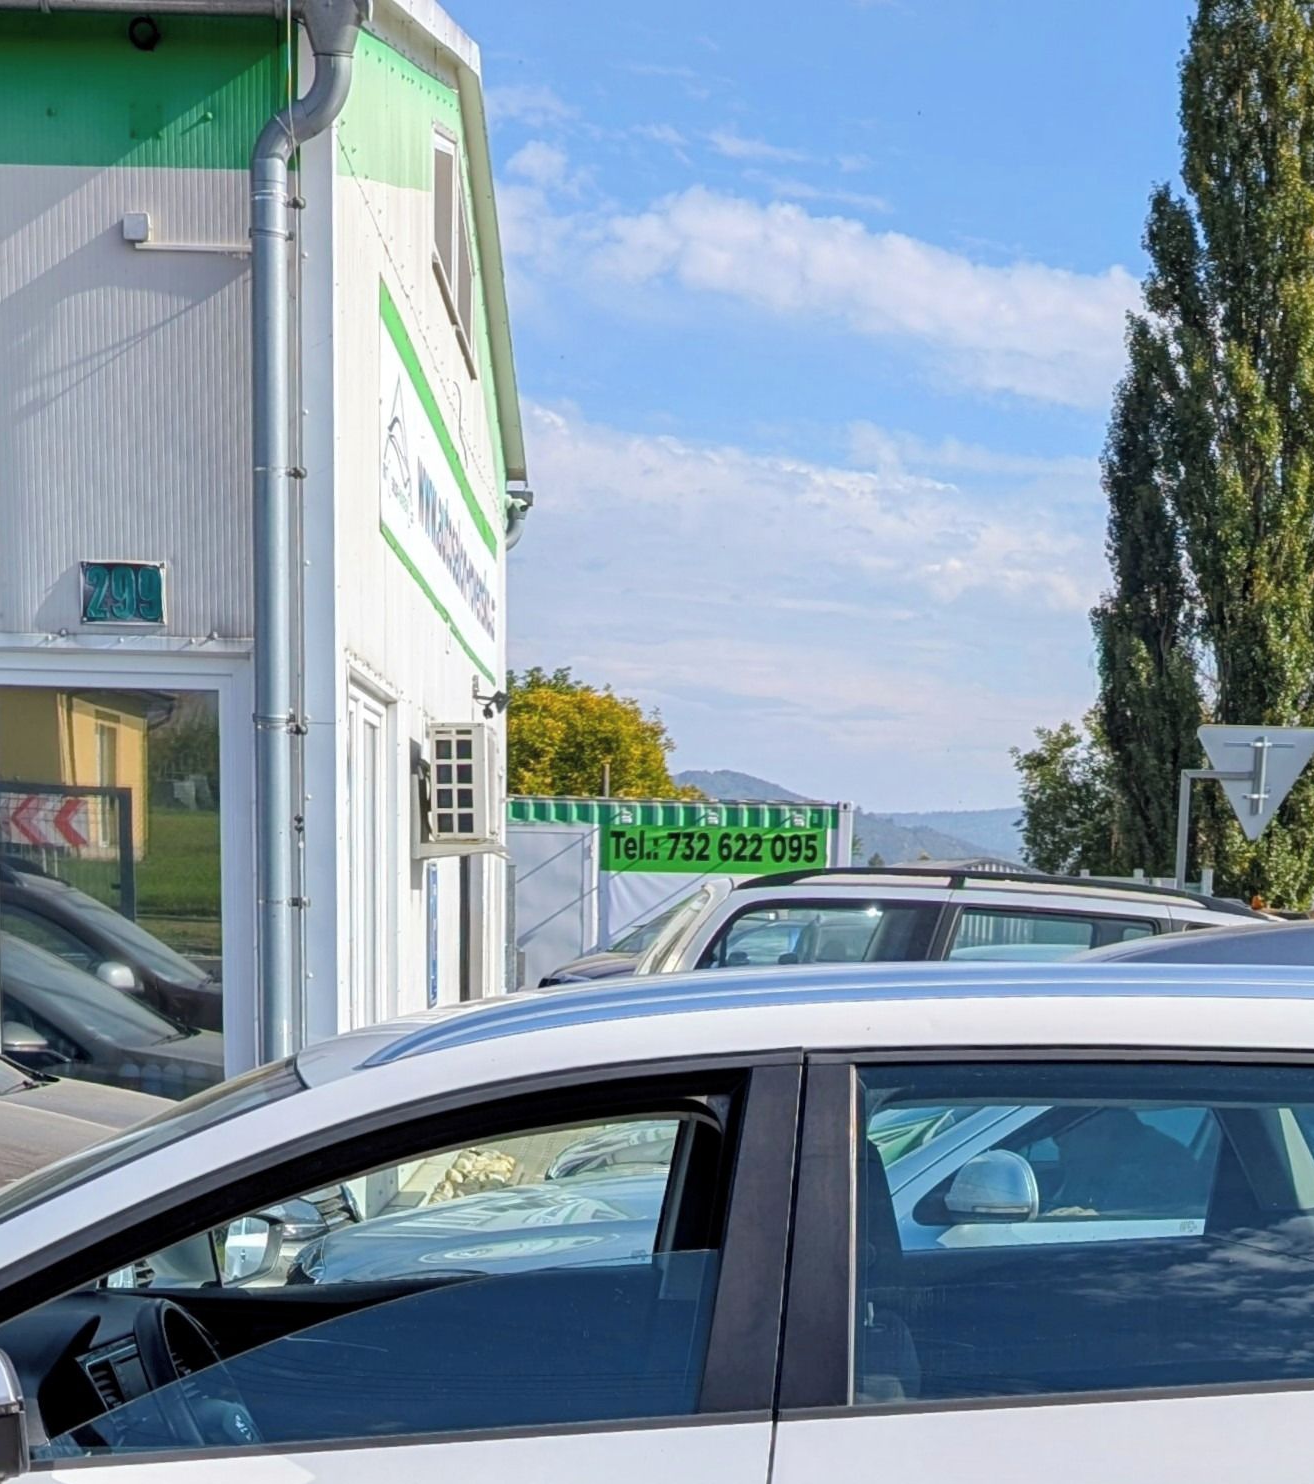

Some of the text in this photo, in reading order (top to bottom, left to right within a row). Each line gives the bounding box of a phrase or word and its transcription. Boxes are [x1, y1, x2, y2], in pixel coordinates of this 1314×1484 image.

[86, 565, 160, 619] 299
[610, 830, 819, 864] Tel.: 732 622 095
